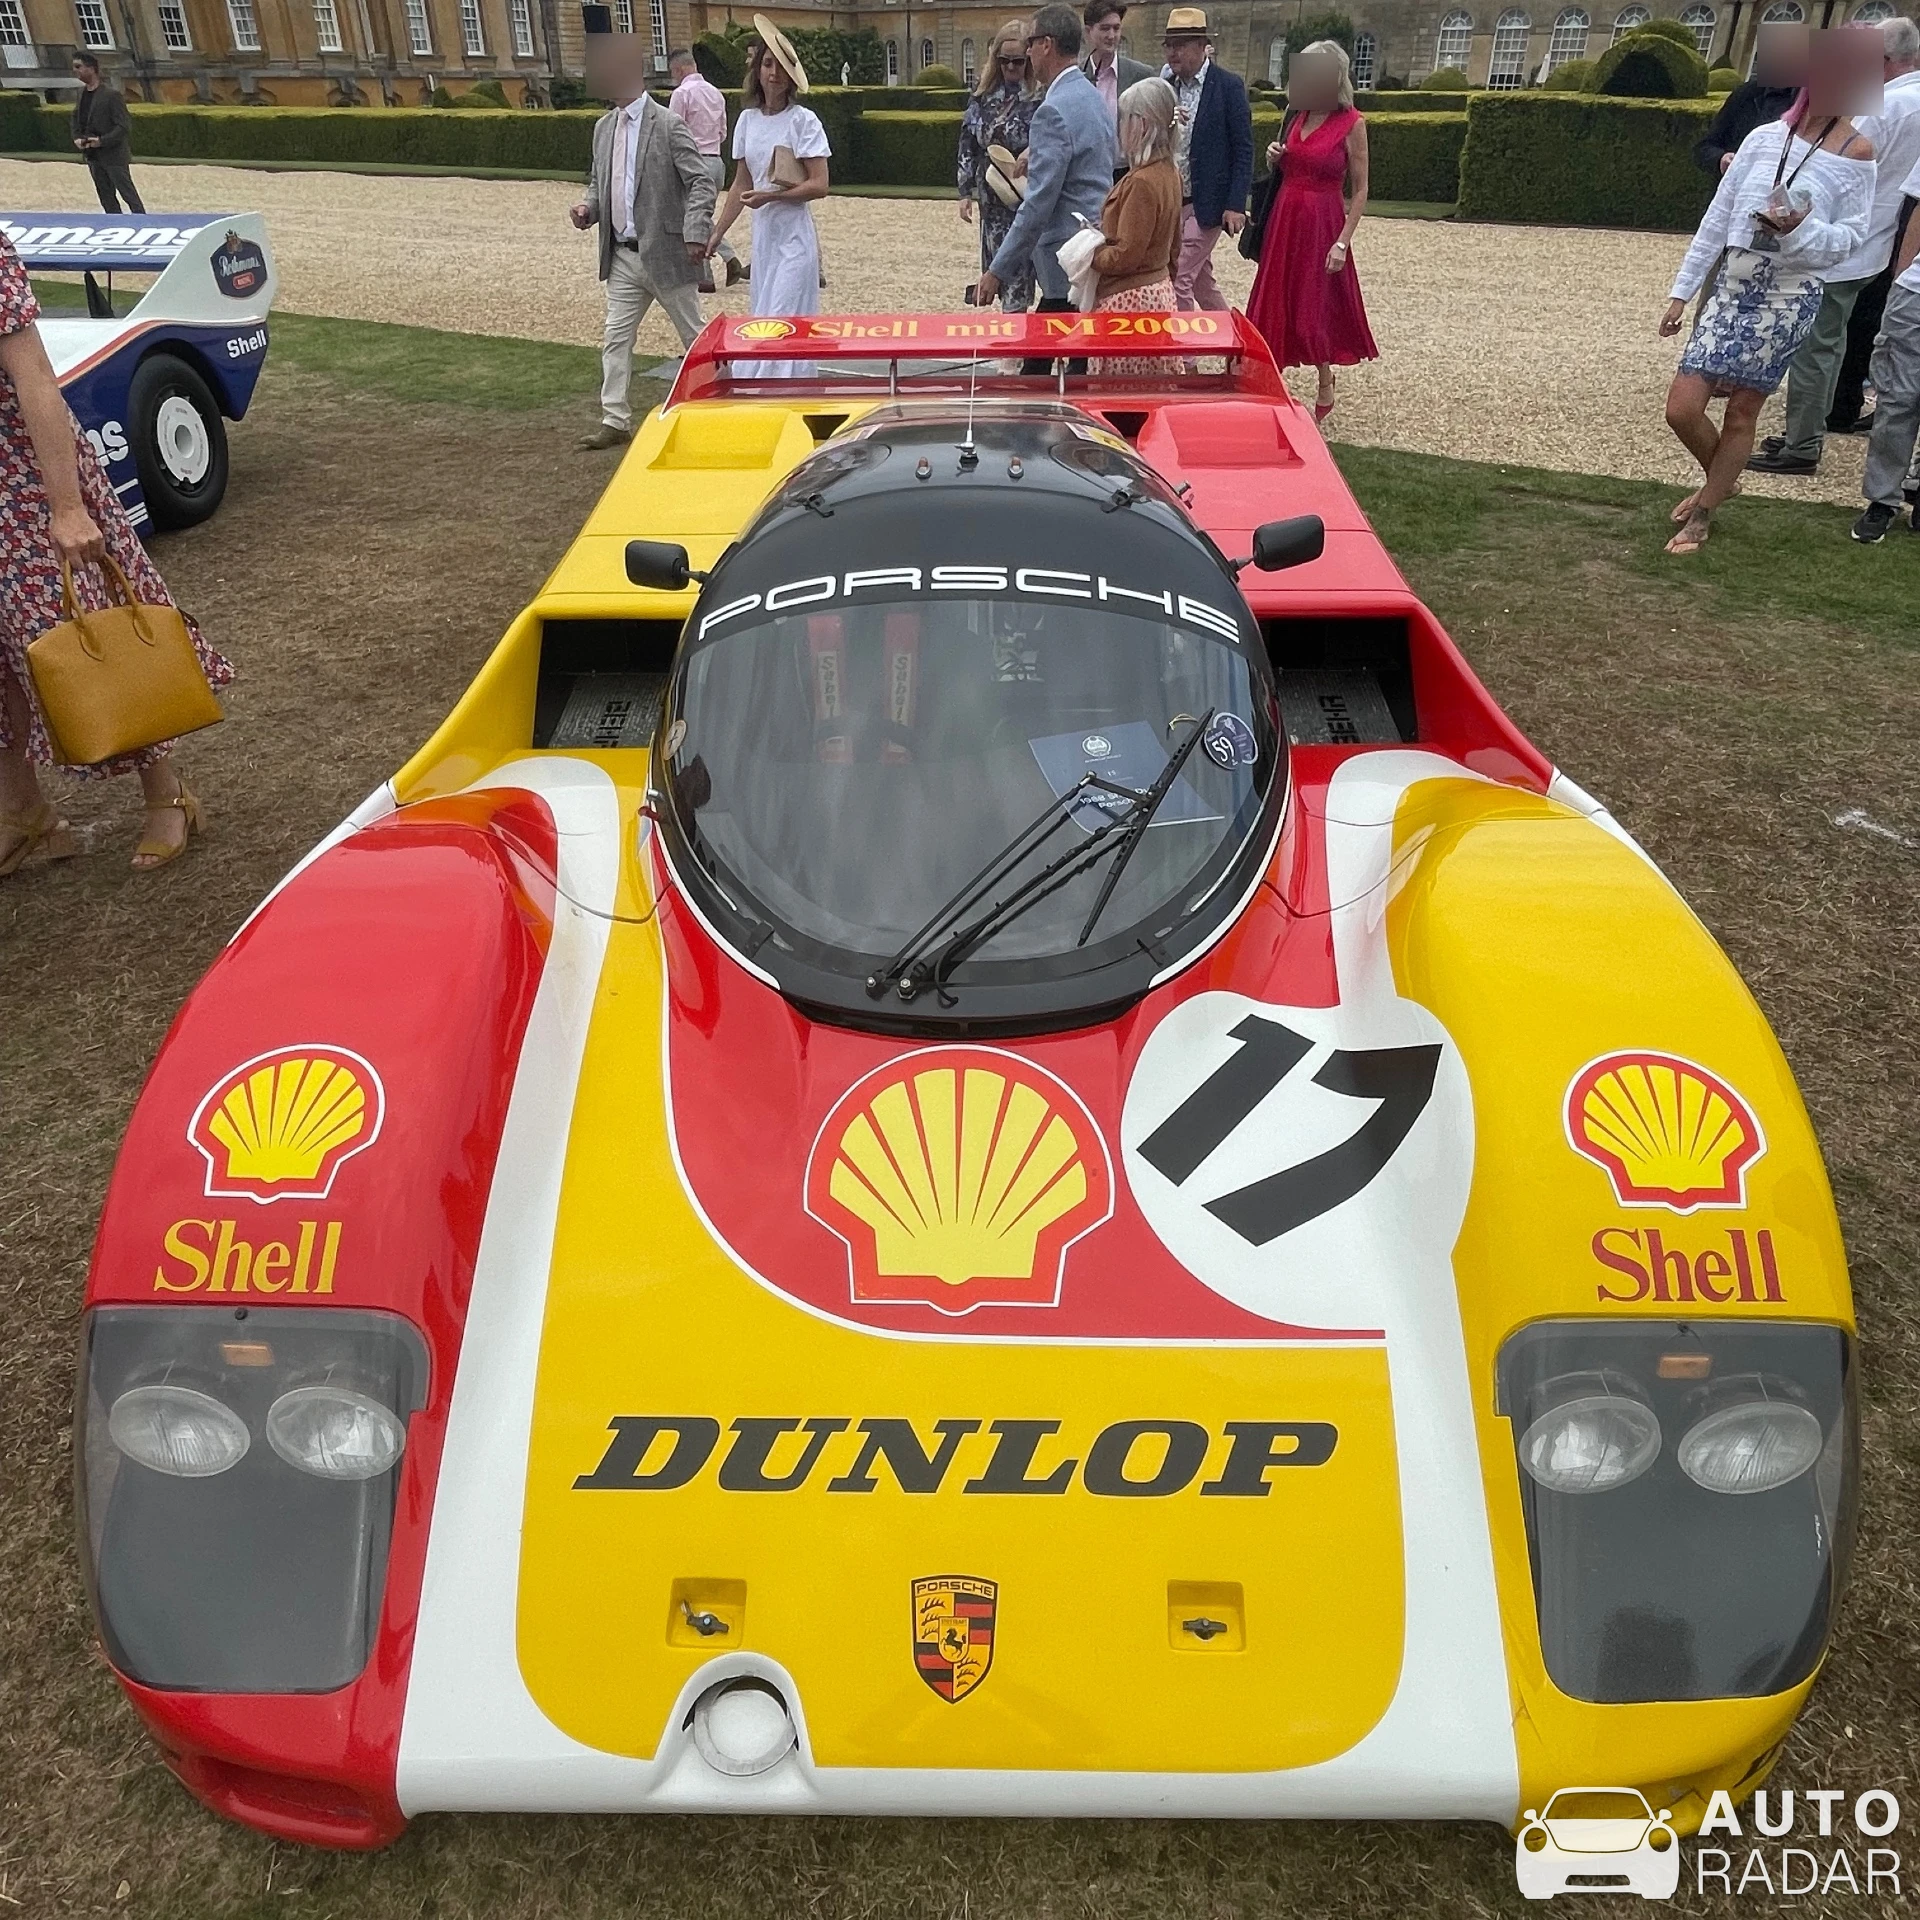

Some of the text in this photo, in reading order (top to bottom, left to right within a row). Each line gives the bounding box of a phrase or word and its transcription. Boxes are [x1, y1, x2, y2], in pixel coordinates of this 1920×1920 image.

[226, 329, 267, 359] Shell
[807, 316, 1218, 339] Shell mit M 2000
[698, 566, 1240, 644] PORSCHE
[1211, 736, 1235, 762] 59
[1136, 1013, 1444, 1247] 17
[153, 1218, 343, 1294] Shell
[1591, 1228, 1788, 1303] Shell
[571, 1415, 1340, 1498] DUNLOP
[916, 1581, 993, 1597] PORSCHE
